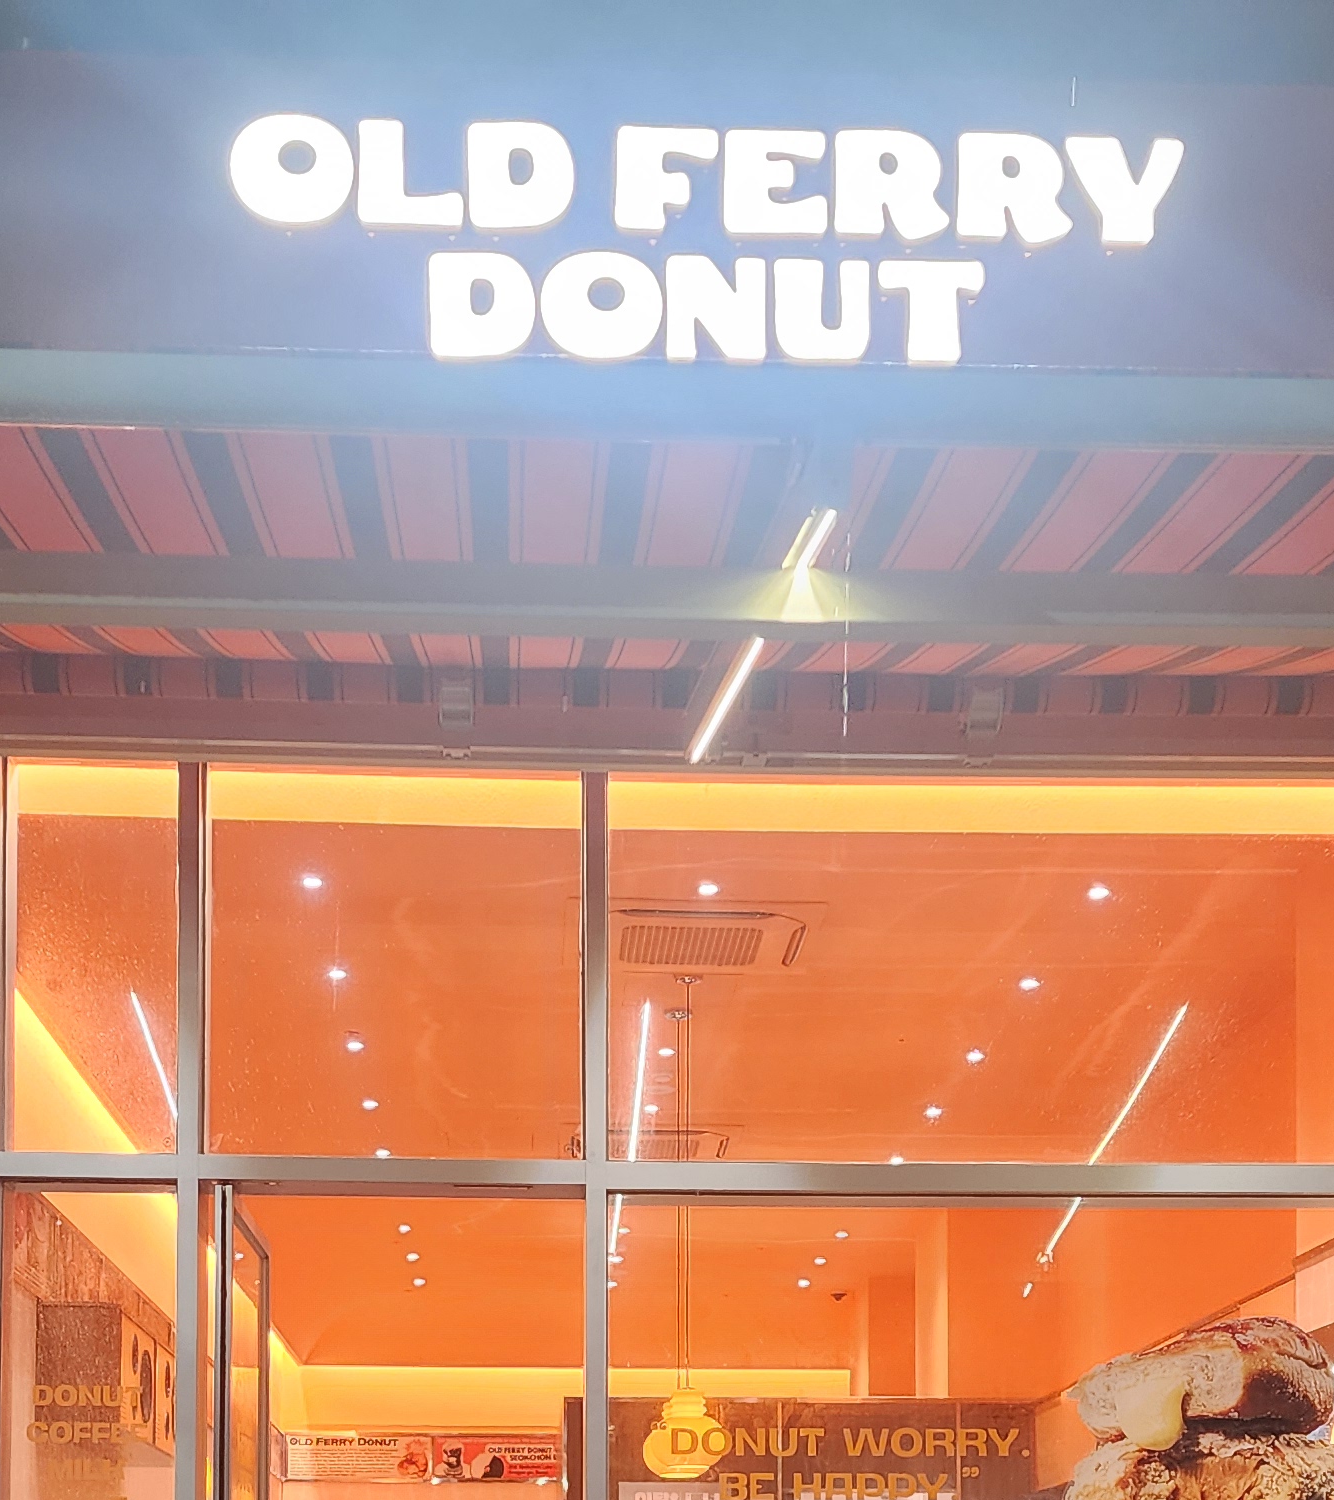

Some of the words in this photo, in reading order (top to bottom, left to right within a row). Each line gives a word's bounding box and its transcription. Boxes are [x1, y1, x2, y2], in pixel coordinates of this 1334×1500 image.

[228, 112, 576, 231] OLD
[613, 124, 1187, 247] FERRY
[426, 250, 986, 367] DONUT
[33, 1384, 142, 1407] DONUT
[27, 1421, 149, 1444] COFFEE
[290, 1438, 313, 1446] OLD
[316, 1437, 355, 1447] FERRY
[357, 1438, 399, 1447] DONUT
[843, 1427, 1031, 1457] WORRY.
[719, 1473, 774, 1500] BE
